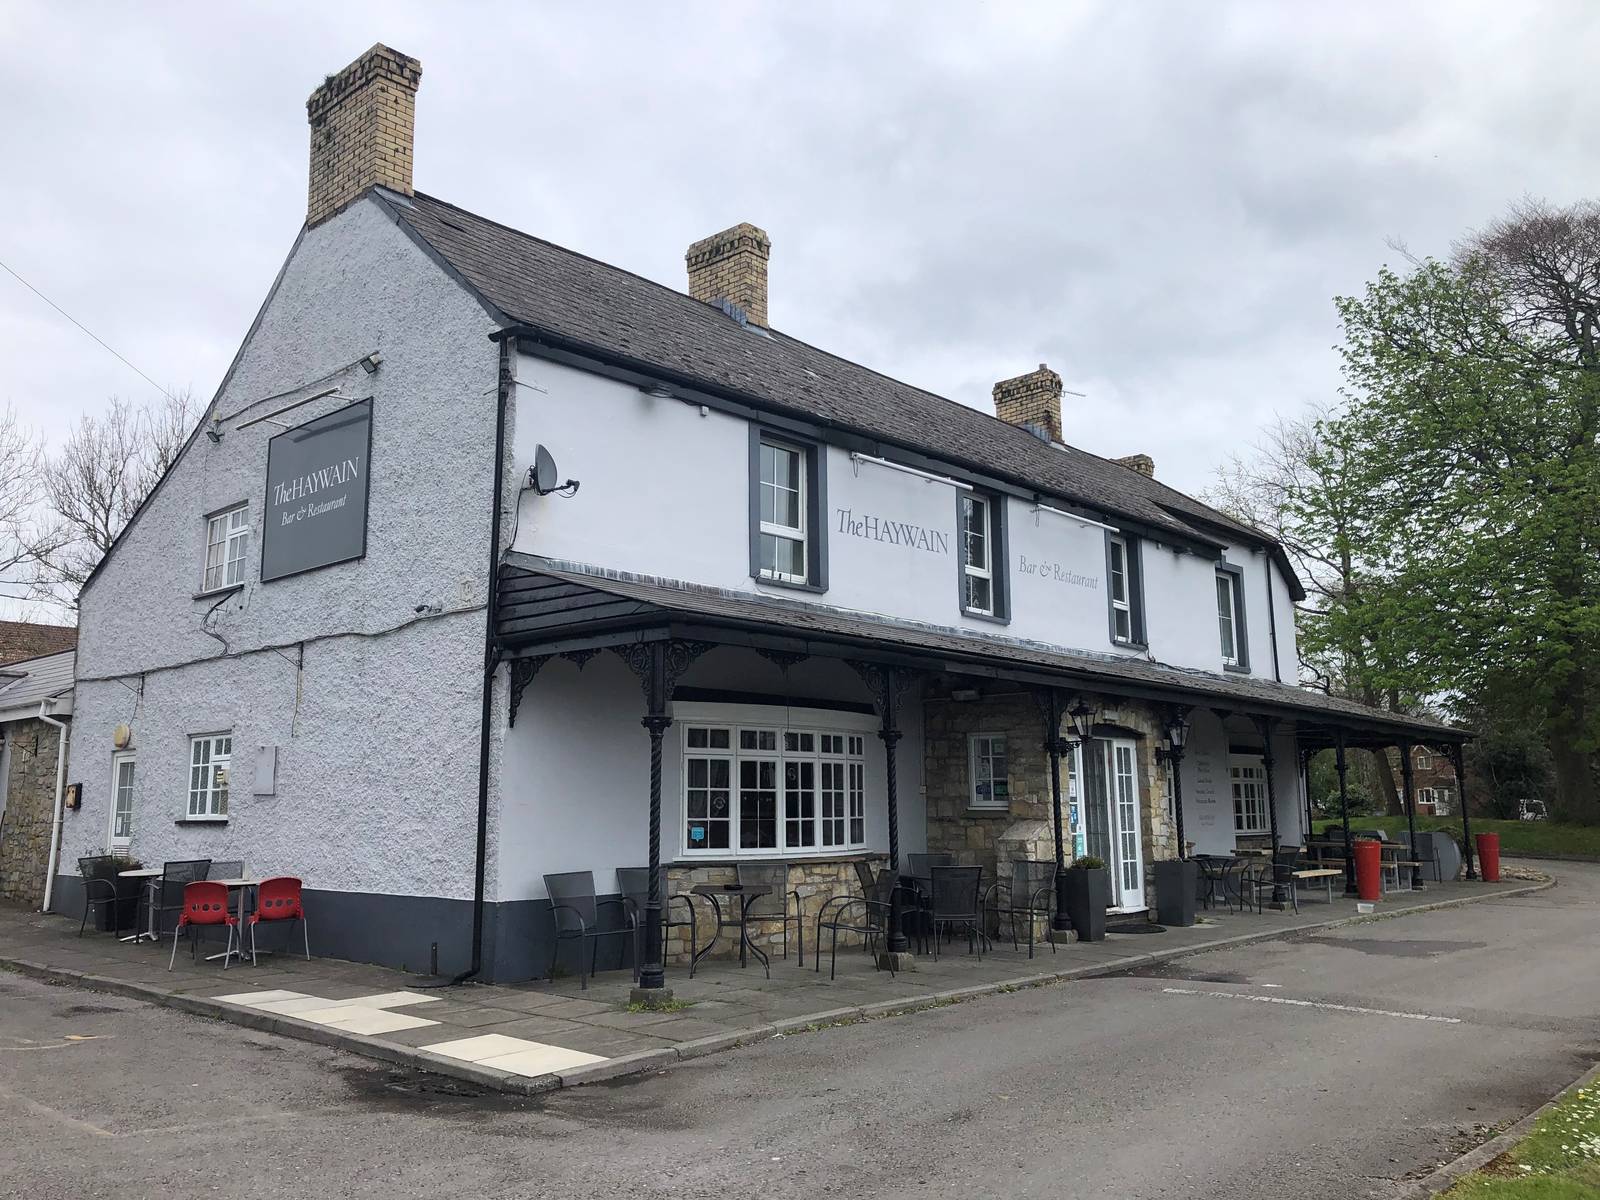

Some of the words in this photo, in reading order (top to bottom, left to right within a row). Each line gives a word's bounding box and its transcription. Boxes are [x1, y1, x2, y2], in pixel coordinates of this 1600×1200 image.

[281, 511, 295, 526] Bar
[296, 505, 307, 521] &
[307, 494, 347, 518] Restaurant
[1019, 554, 1037, 575] Bar
[1039, 560, 1052, 577] &
[1053, 563, 1098, 590] Restaurant
